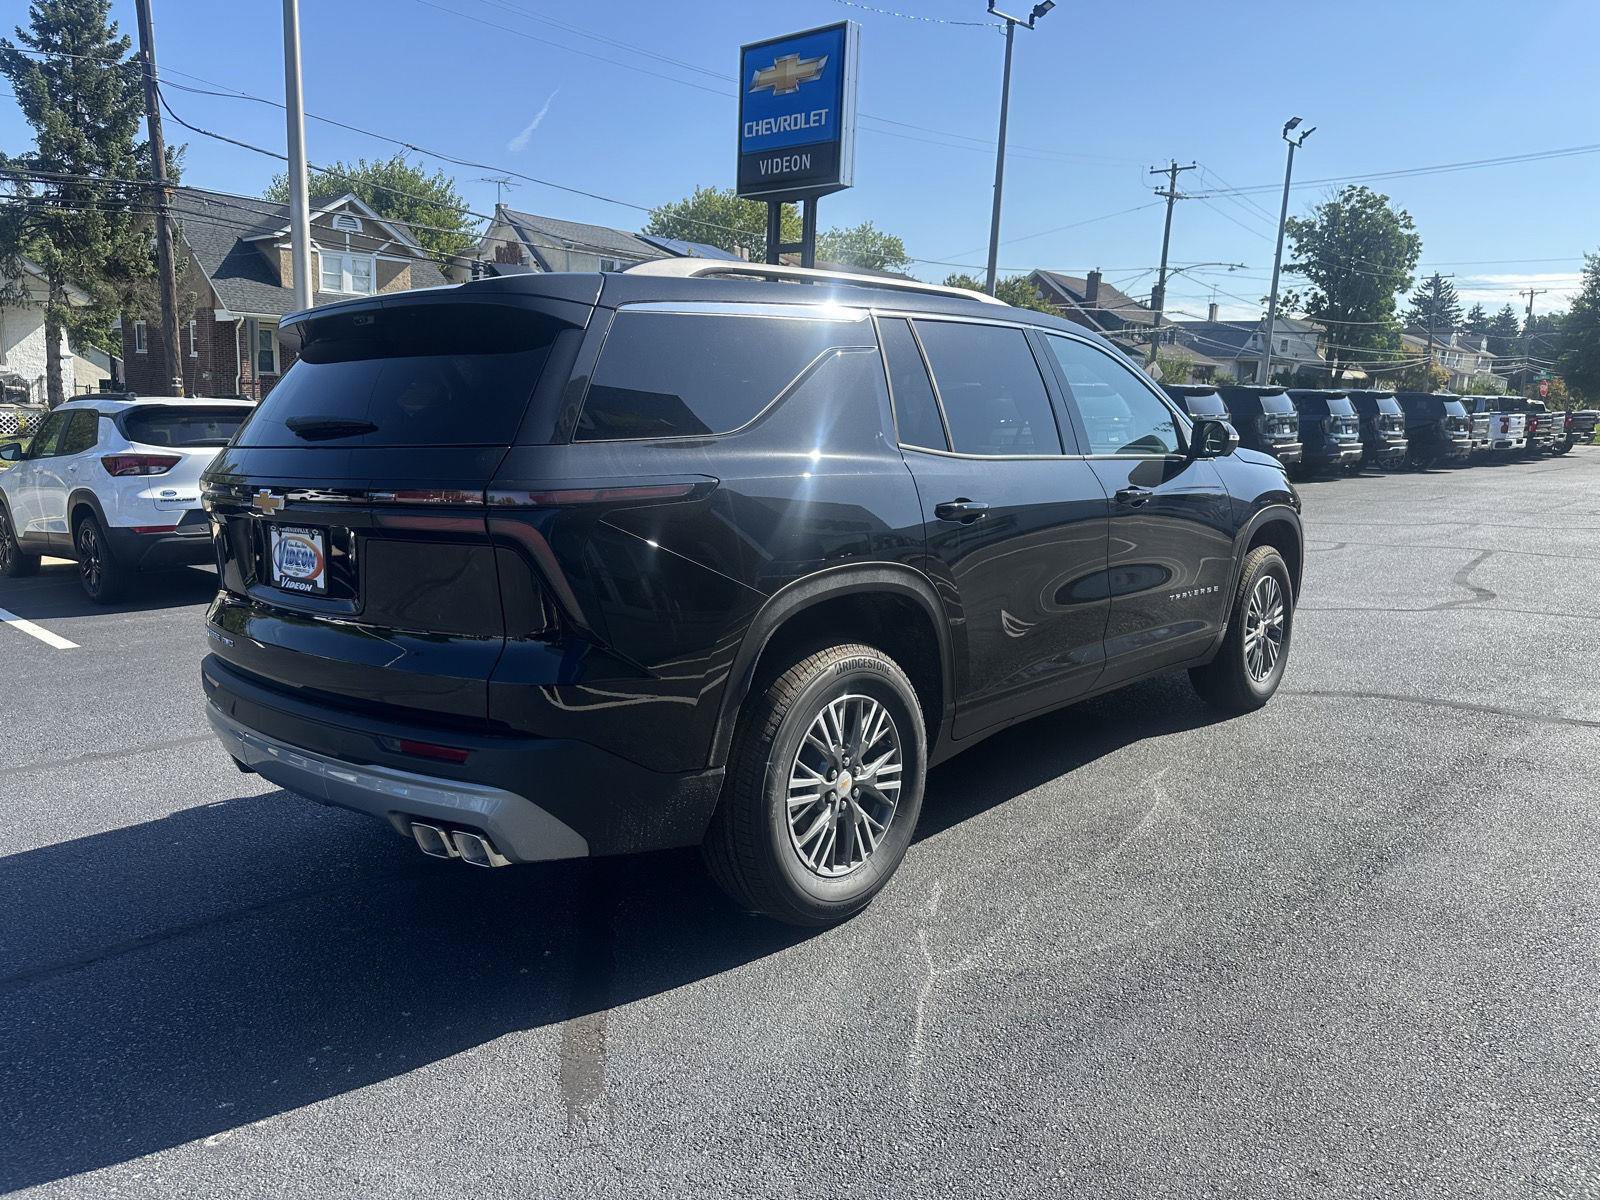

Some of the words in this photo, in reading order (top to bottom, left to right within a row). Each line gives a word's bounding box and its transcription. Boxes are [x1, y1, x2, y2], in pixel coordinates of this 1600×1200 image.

[744, 109, 829, 138] CHEVROLET
[759, 154, 811, 175] VIDEON
[281, 576, 313, 592] VIDEON
[1169, 586, 1219, 601] TRAVERSE
